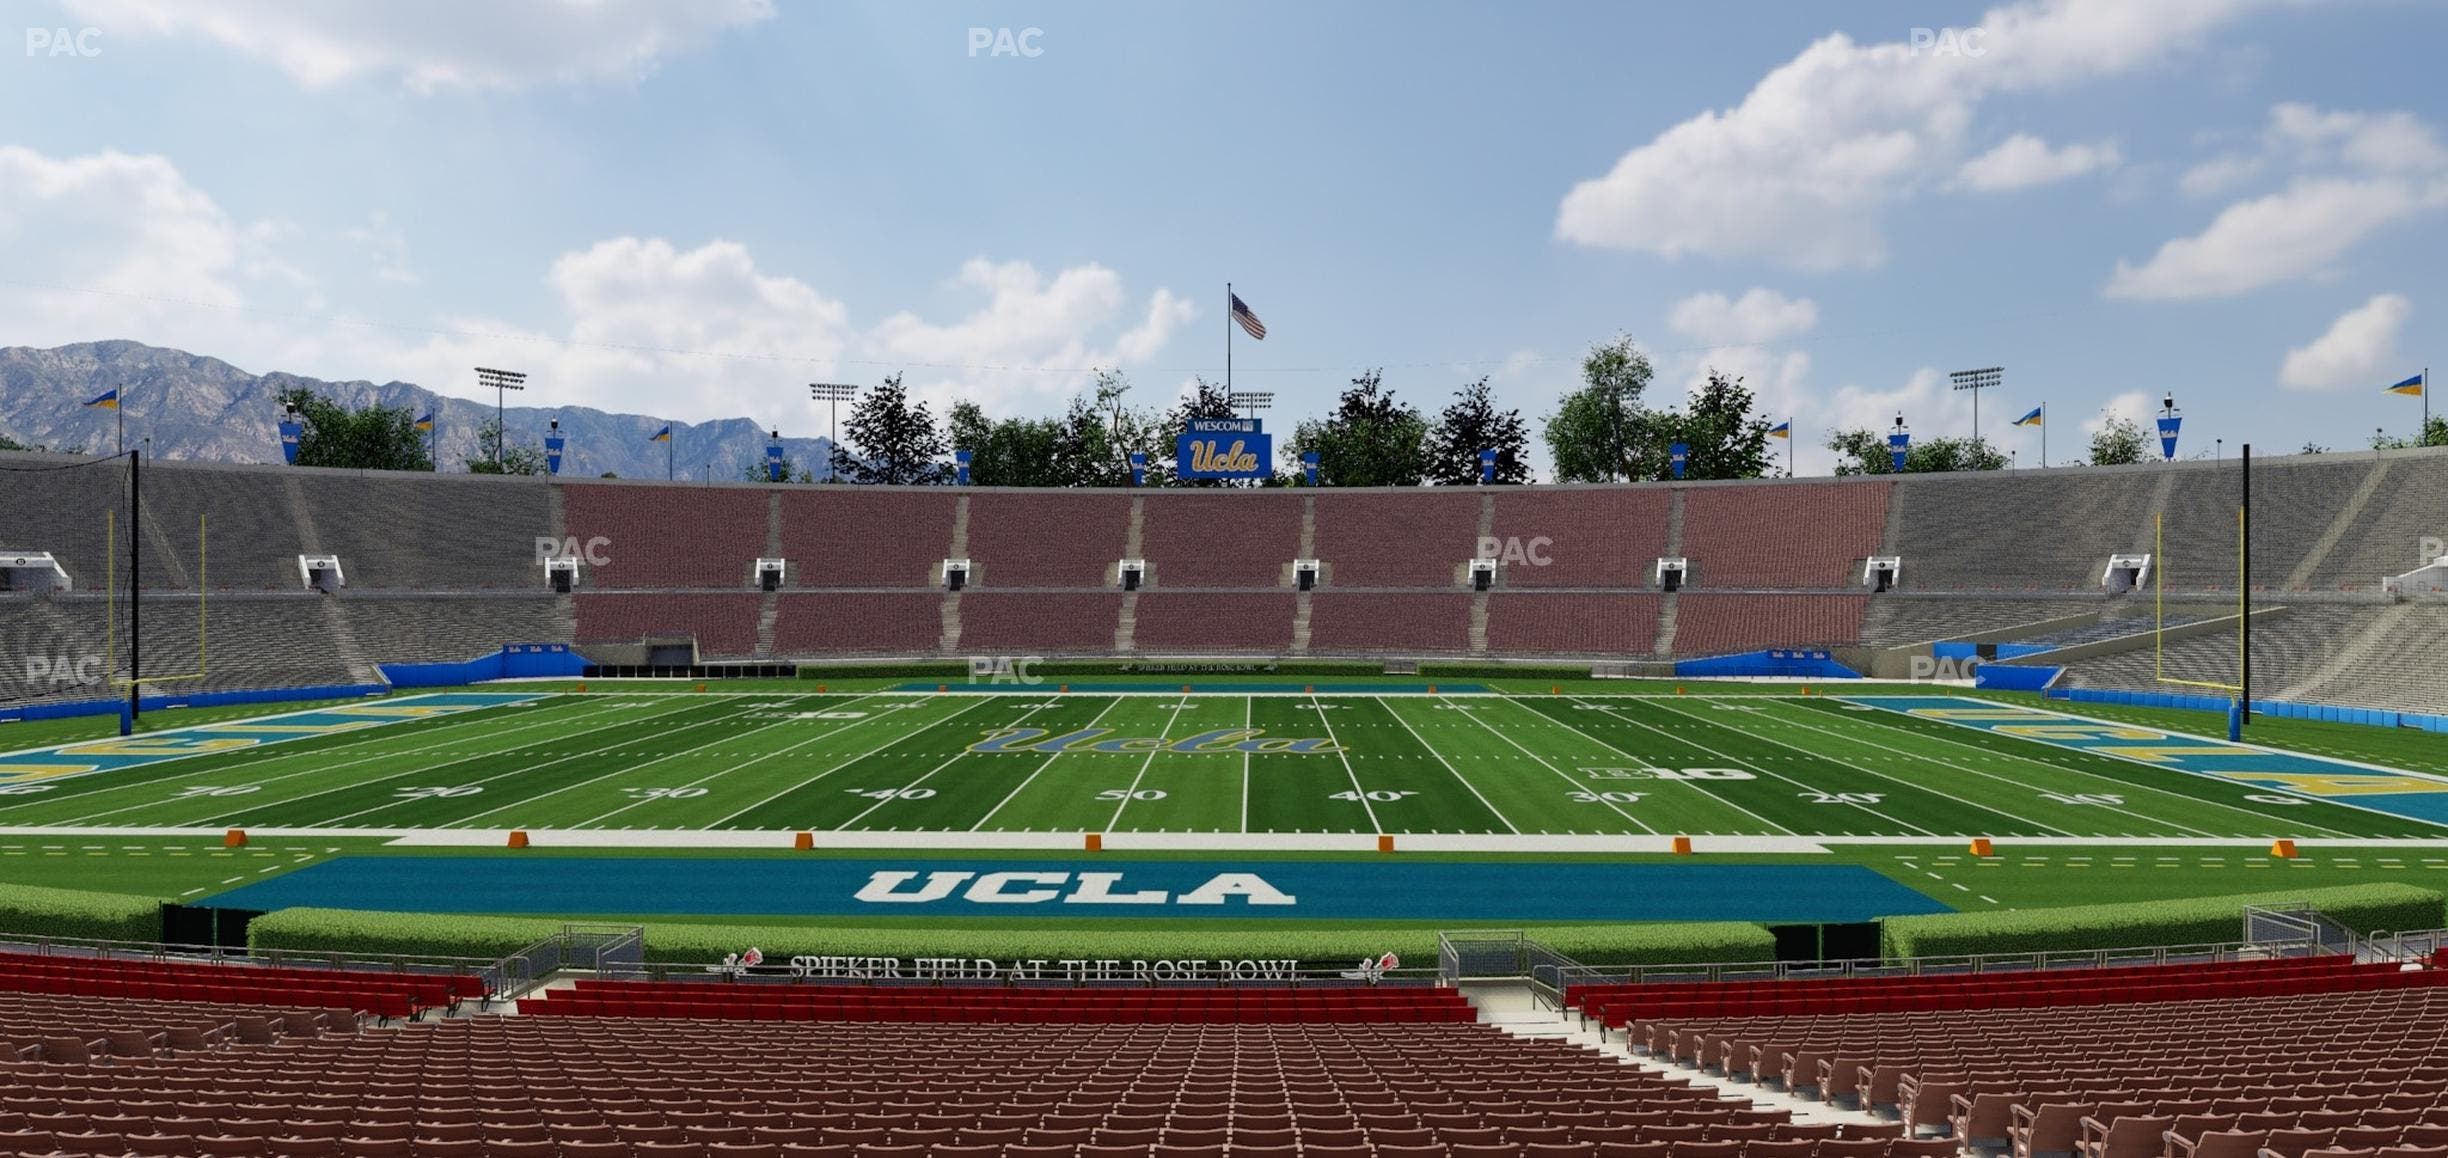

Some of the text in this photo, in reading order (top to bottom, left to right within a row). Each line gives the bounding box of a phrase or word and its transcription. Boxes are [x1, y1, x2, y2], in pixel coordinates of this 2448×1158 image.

[1194, 421, 1241, 431] WESCOM
[860, 788, 937, 800] 40
[1095, 789, 1168, 801] 50
[1328, 790, 1402, 802] 40
[853, 870, 1297, 906] UCLA
[790, 955, 1307, 982] SPIEKER FIELD AT THE ROSE BOWL
